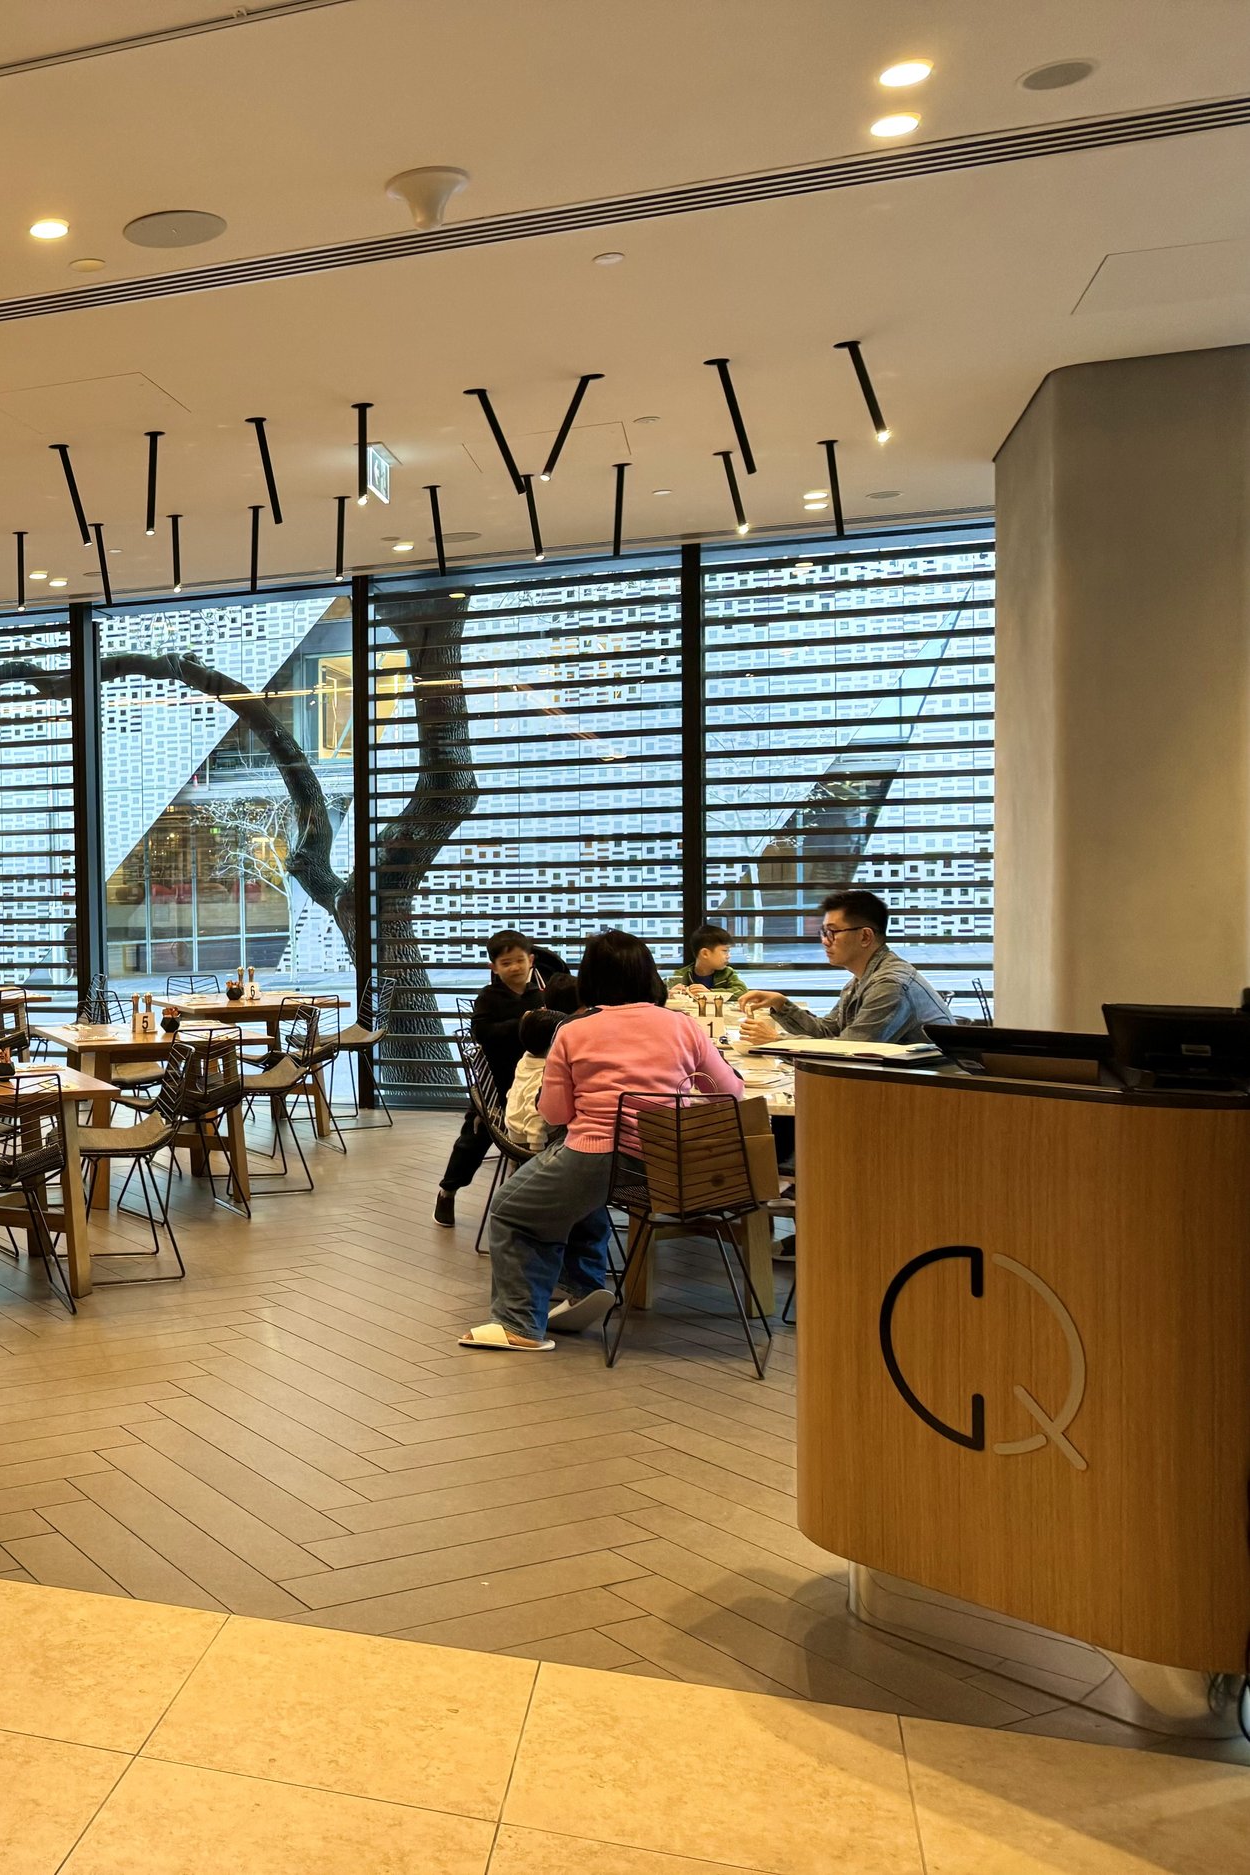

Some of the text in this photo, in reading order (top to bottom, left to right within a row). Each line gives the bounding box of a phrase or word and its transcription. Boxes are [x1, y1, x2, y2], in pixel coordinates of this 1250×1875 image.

[250, 985, 256, 998] 6
[142, 1015, 149, 1030] 5
[707, 1021, 713, 1038] 1
